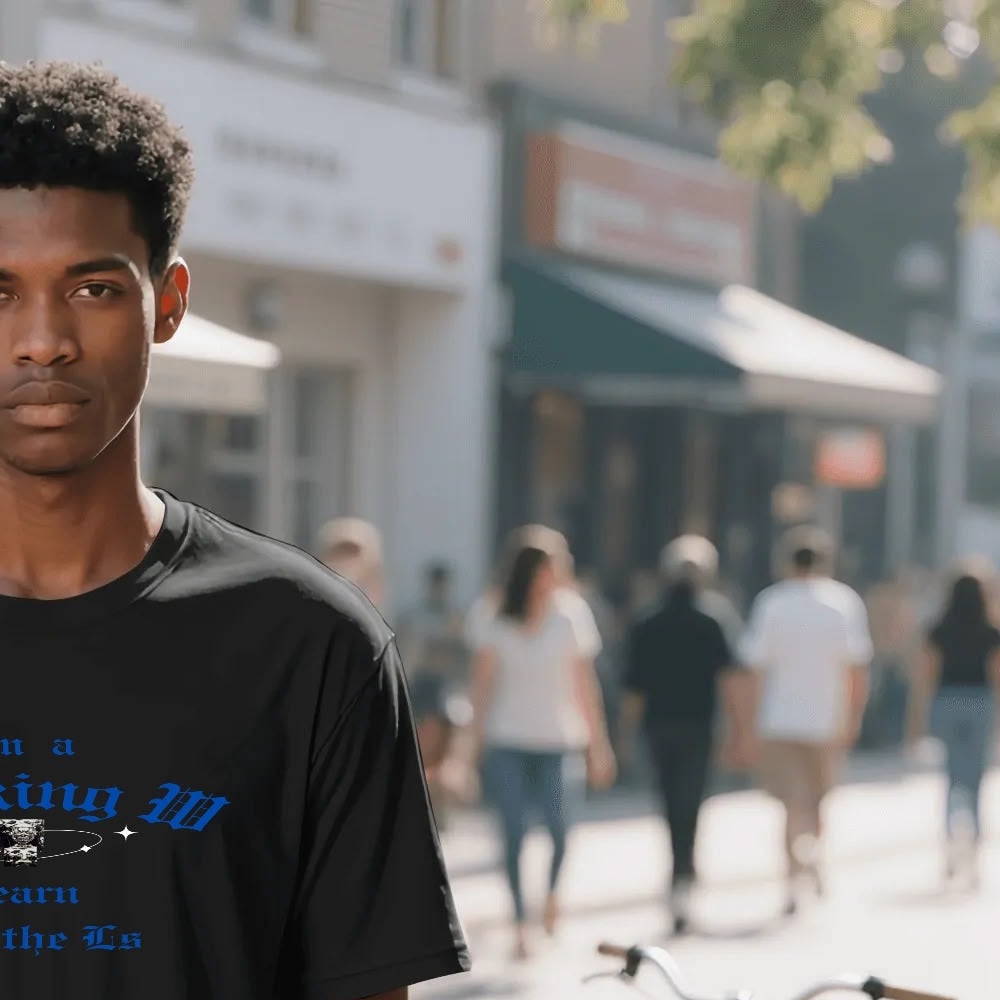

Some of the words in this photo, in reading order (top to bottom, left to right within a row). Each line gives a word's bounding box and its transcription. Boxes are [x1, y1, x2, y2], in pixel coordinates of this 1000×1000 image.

[51, 737, 76, 757] a
[138, 782, 231, 832] W
[1, 925, 69, 956] the
[82, 924, 142, 951] Ls
